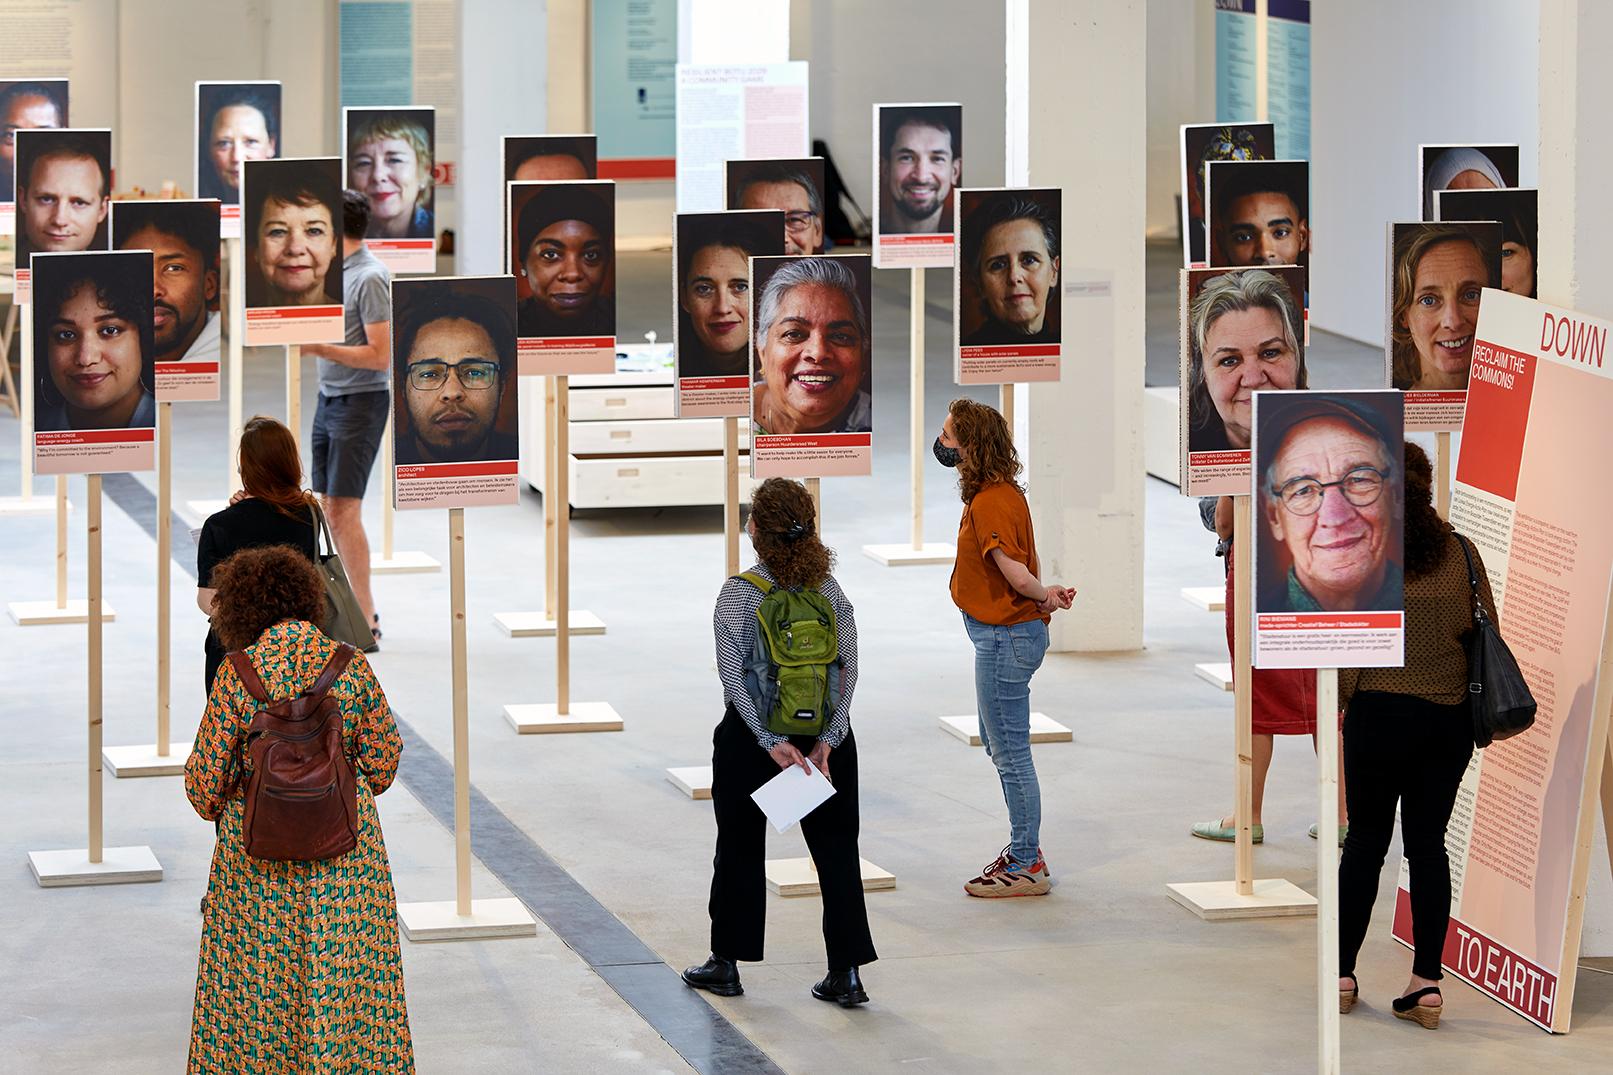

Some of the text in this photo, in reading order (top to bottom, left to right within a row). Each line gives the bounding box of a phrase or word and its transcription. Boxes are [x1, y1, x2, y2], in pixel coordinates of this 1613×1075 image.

[1475, 344, 1526, 374] RECLAIM THE
[1540, 312, 1606, 368] DOWN
[1472, 364, 1514, 390] COMMONS!
[1457, 927, 1555, 1024] TO EARTH
